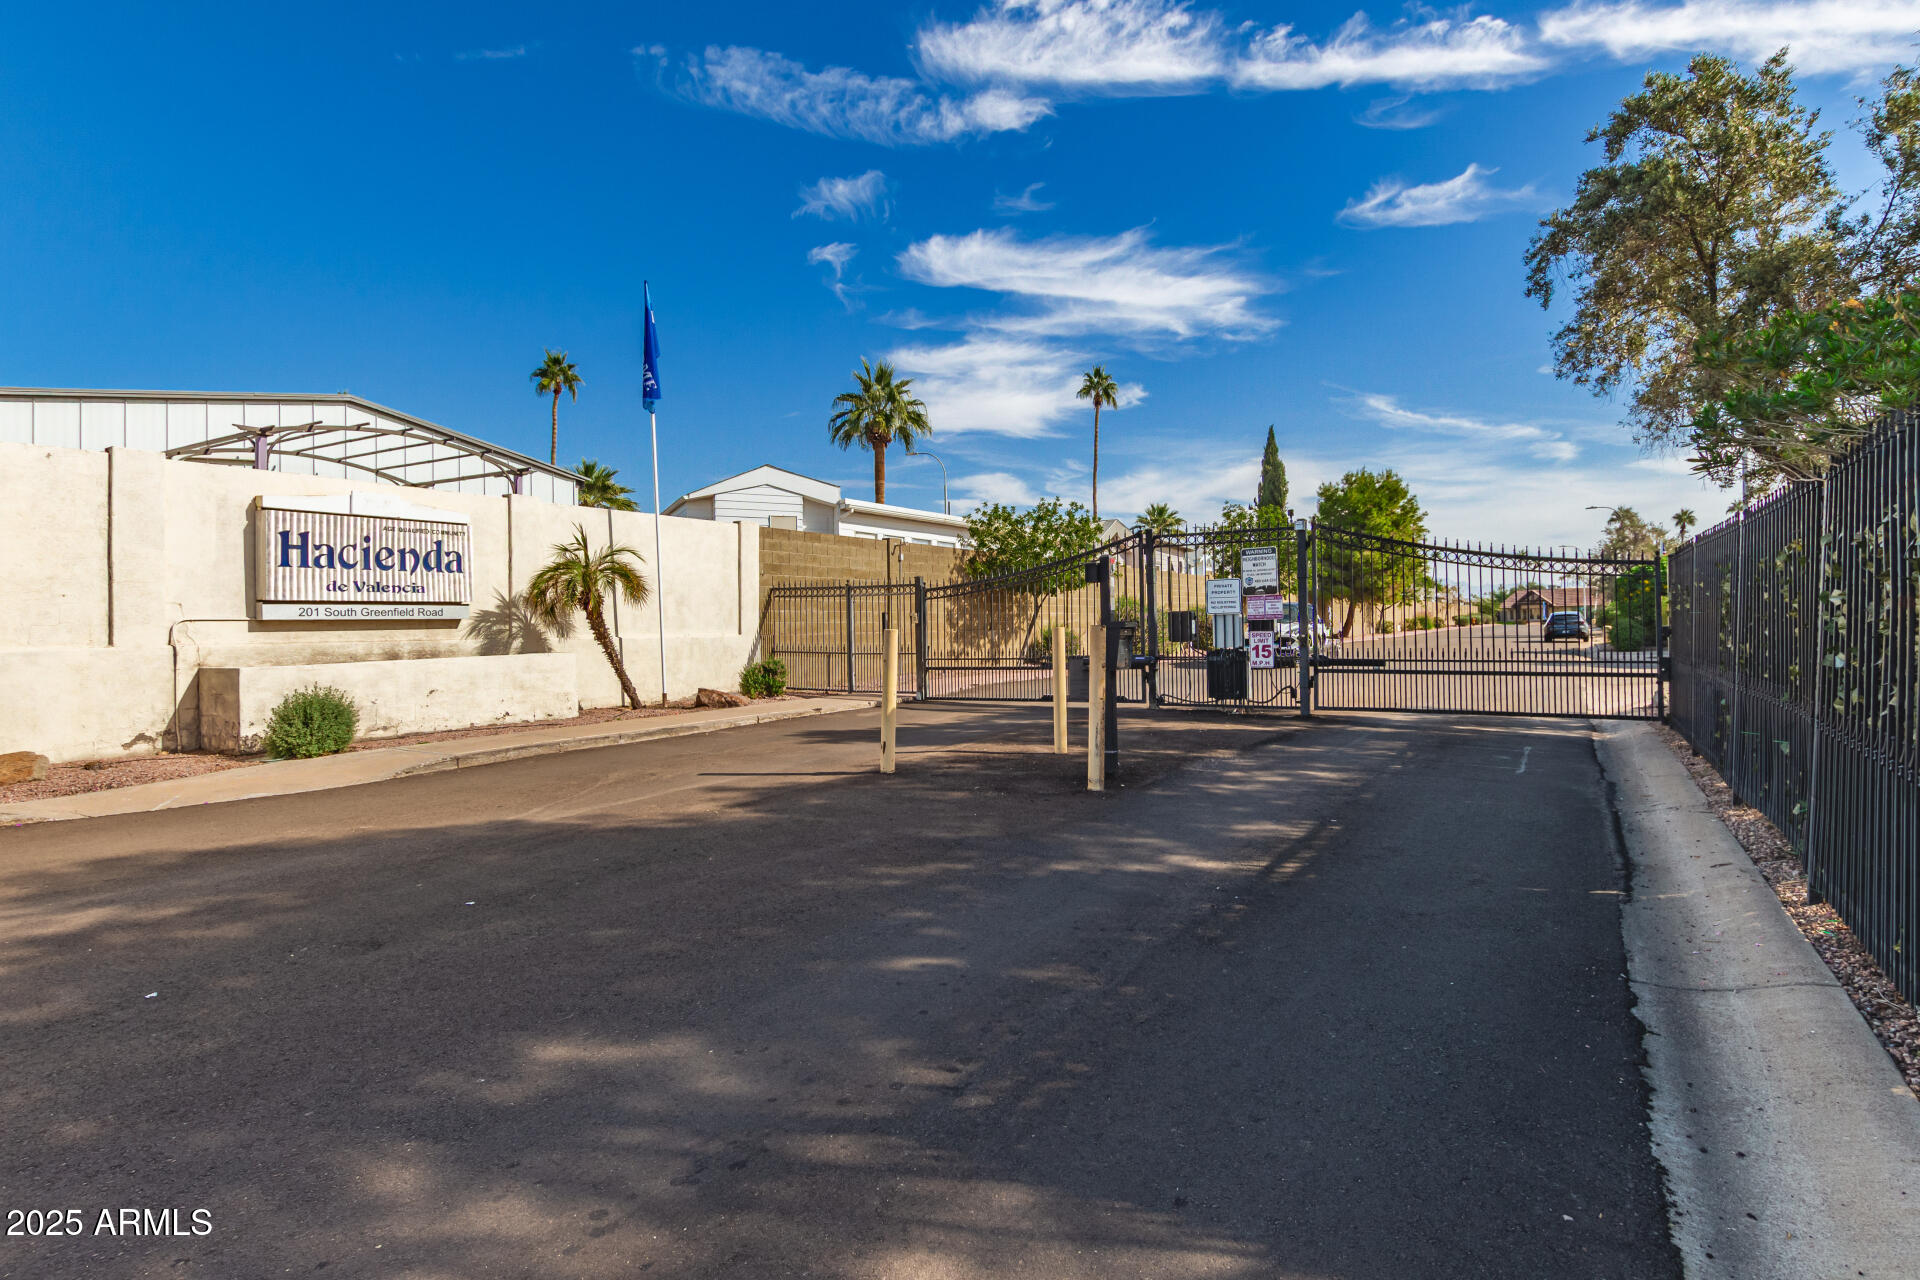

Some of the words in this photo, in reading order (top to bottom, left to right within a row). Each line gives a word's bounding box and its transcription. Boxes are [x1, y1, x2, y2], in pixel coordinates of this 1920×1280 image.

[277, 529, 464, 576] Hacienda
[326, 581, 348, 593] de
[353, 580, 426, 594] Valencia
[298, 607, 319, 617] 201
[324, 607, 357, 617] South
[360, 607, 415, 618] Greenfield
[417, 607, 444, 617] Road
[1251, 644, 1272, 658] 15
